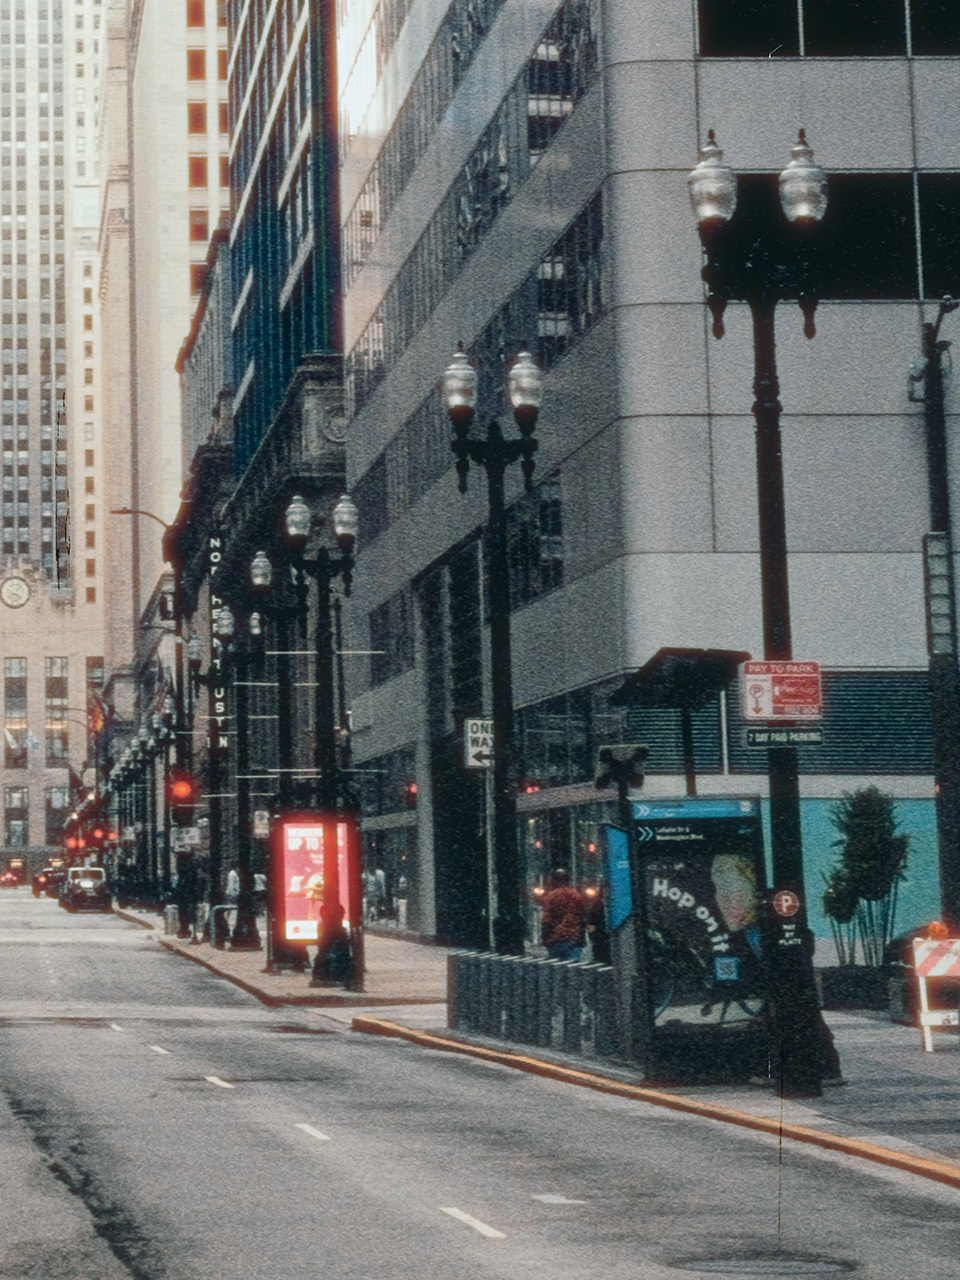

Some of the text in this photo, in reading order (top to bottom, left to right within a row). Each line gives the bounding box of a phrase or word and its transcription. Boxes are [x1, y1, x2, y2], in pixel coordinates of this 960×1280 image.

[748, 664, 814, 673] PAY TO PARK
[287, 837, 319, 851] UP TO
[652, 878, 696, 908] Hop
[695, 906, 719, 933] on
[710, 933, 730, 953] it
